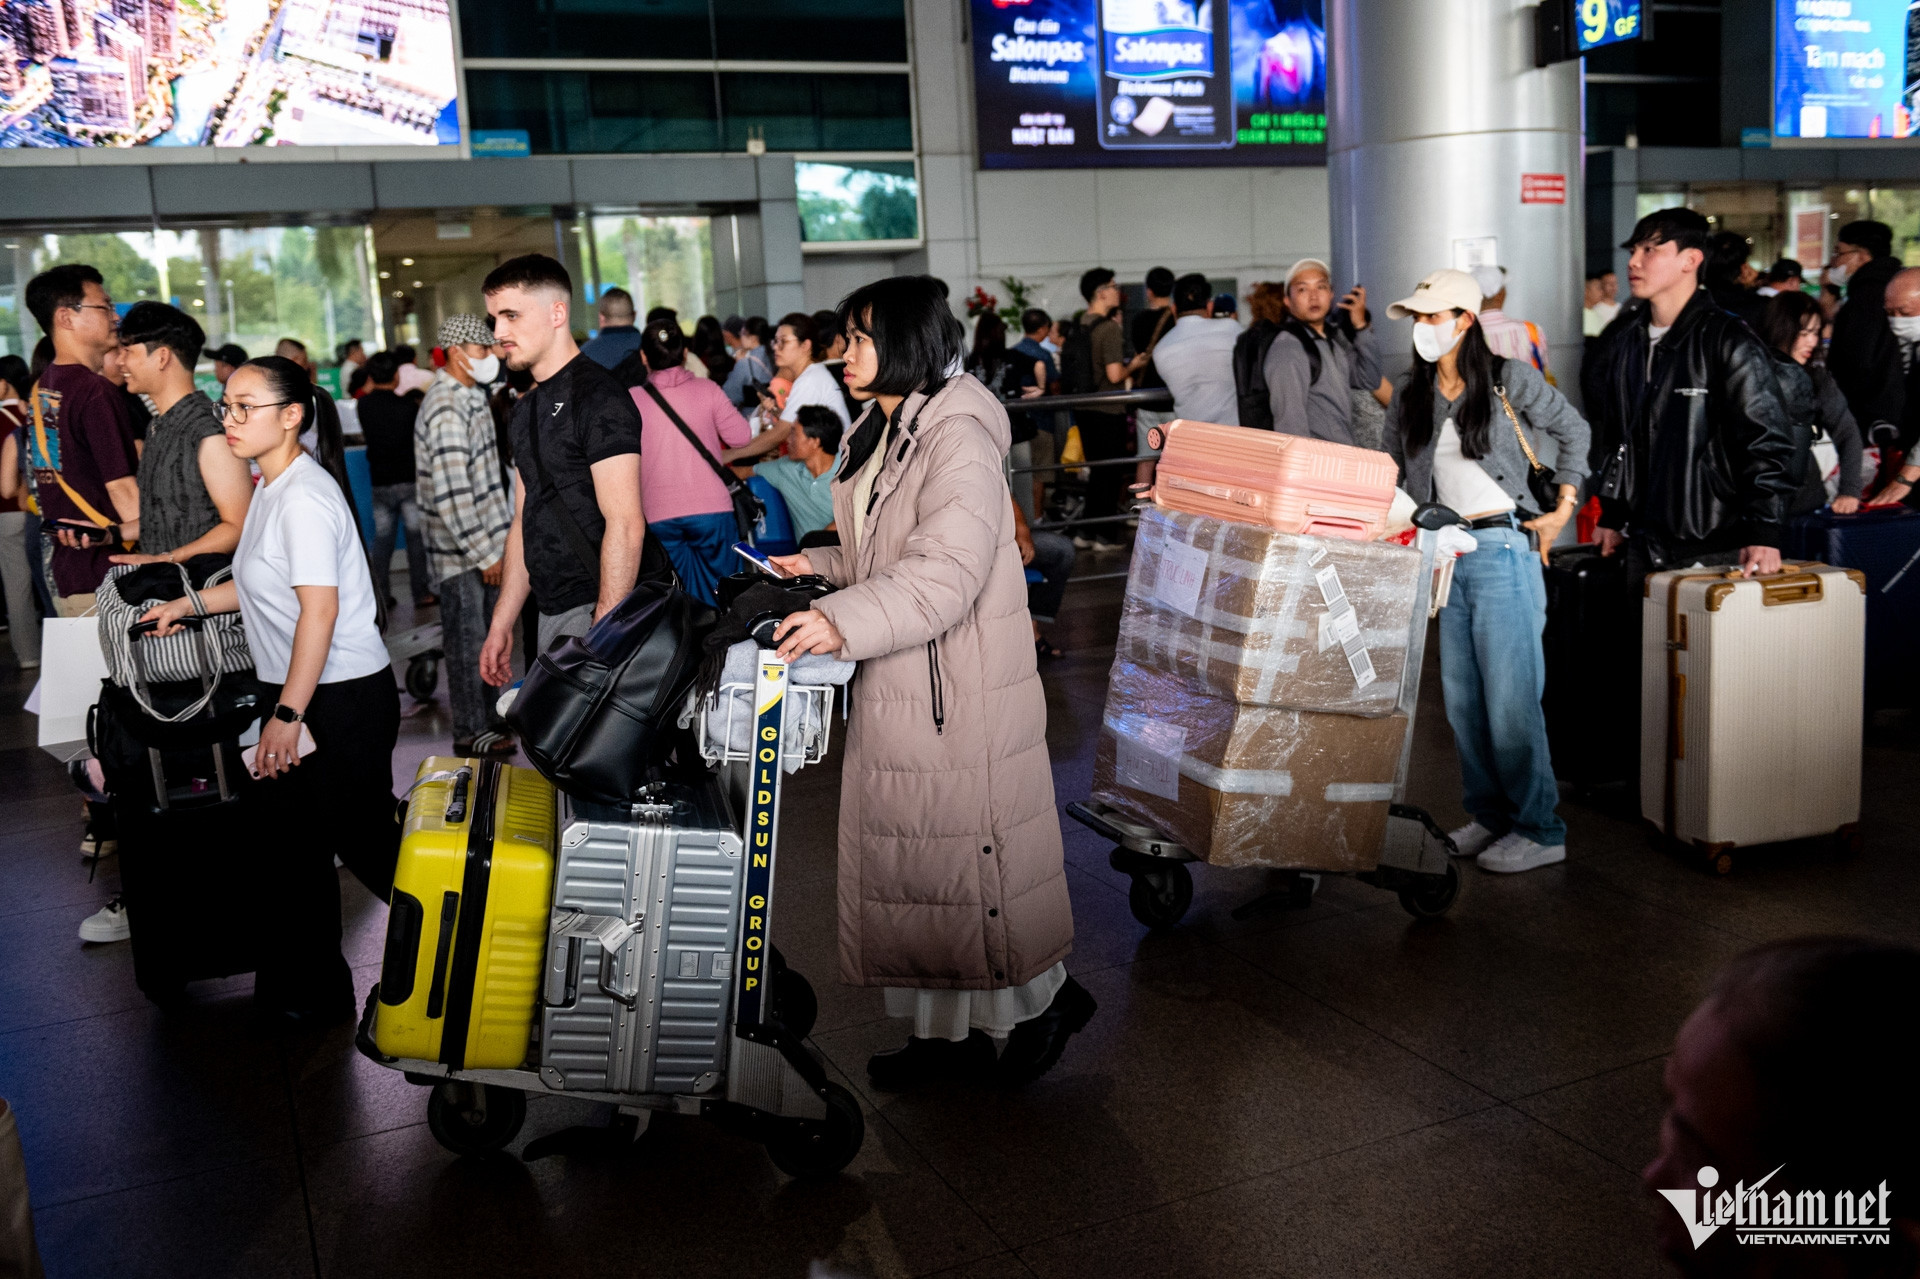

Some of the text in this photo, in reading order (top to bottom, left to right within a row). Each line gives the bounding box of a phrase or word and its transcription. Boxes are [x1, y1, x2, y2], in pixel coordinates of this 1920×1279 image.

[1582, 0, 1637, 43] 9 GF
[991, 34, 1085, 66] Salonpas
[1114, 37, 1204, 67] Salonpas
[753, 726, 777, 868] GOLDSUN
[745, 895, 765, 991] GROUP
